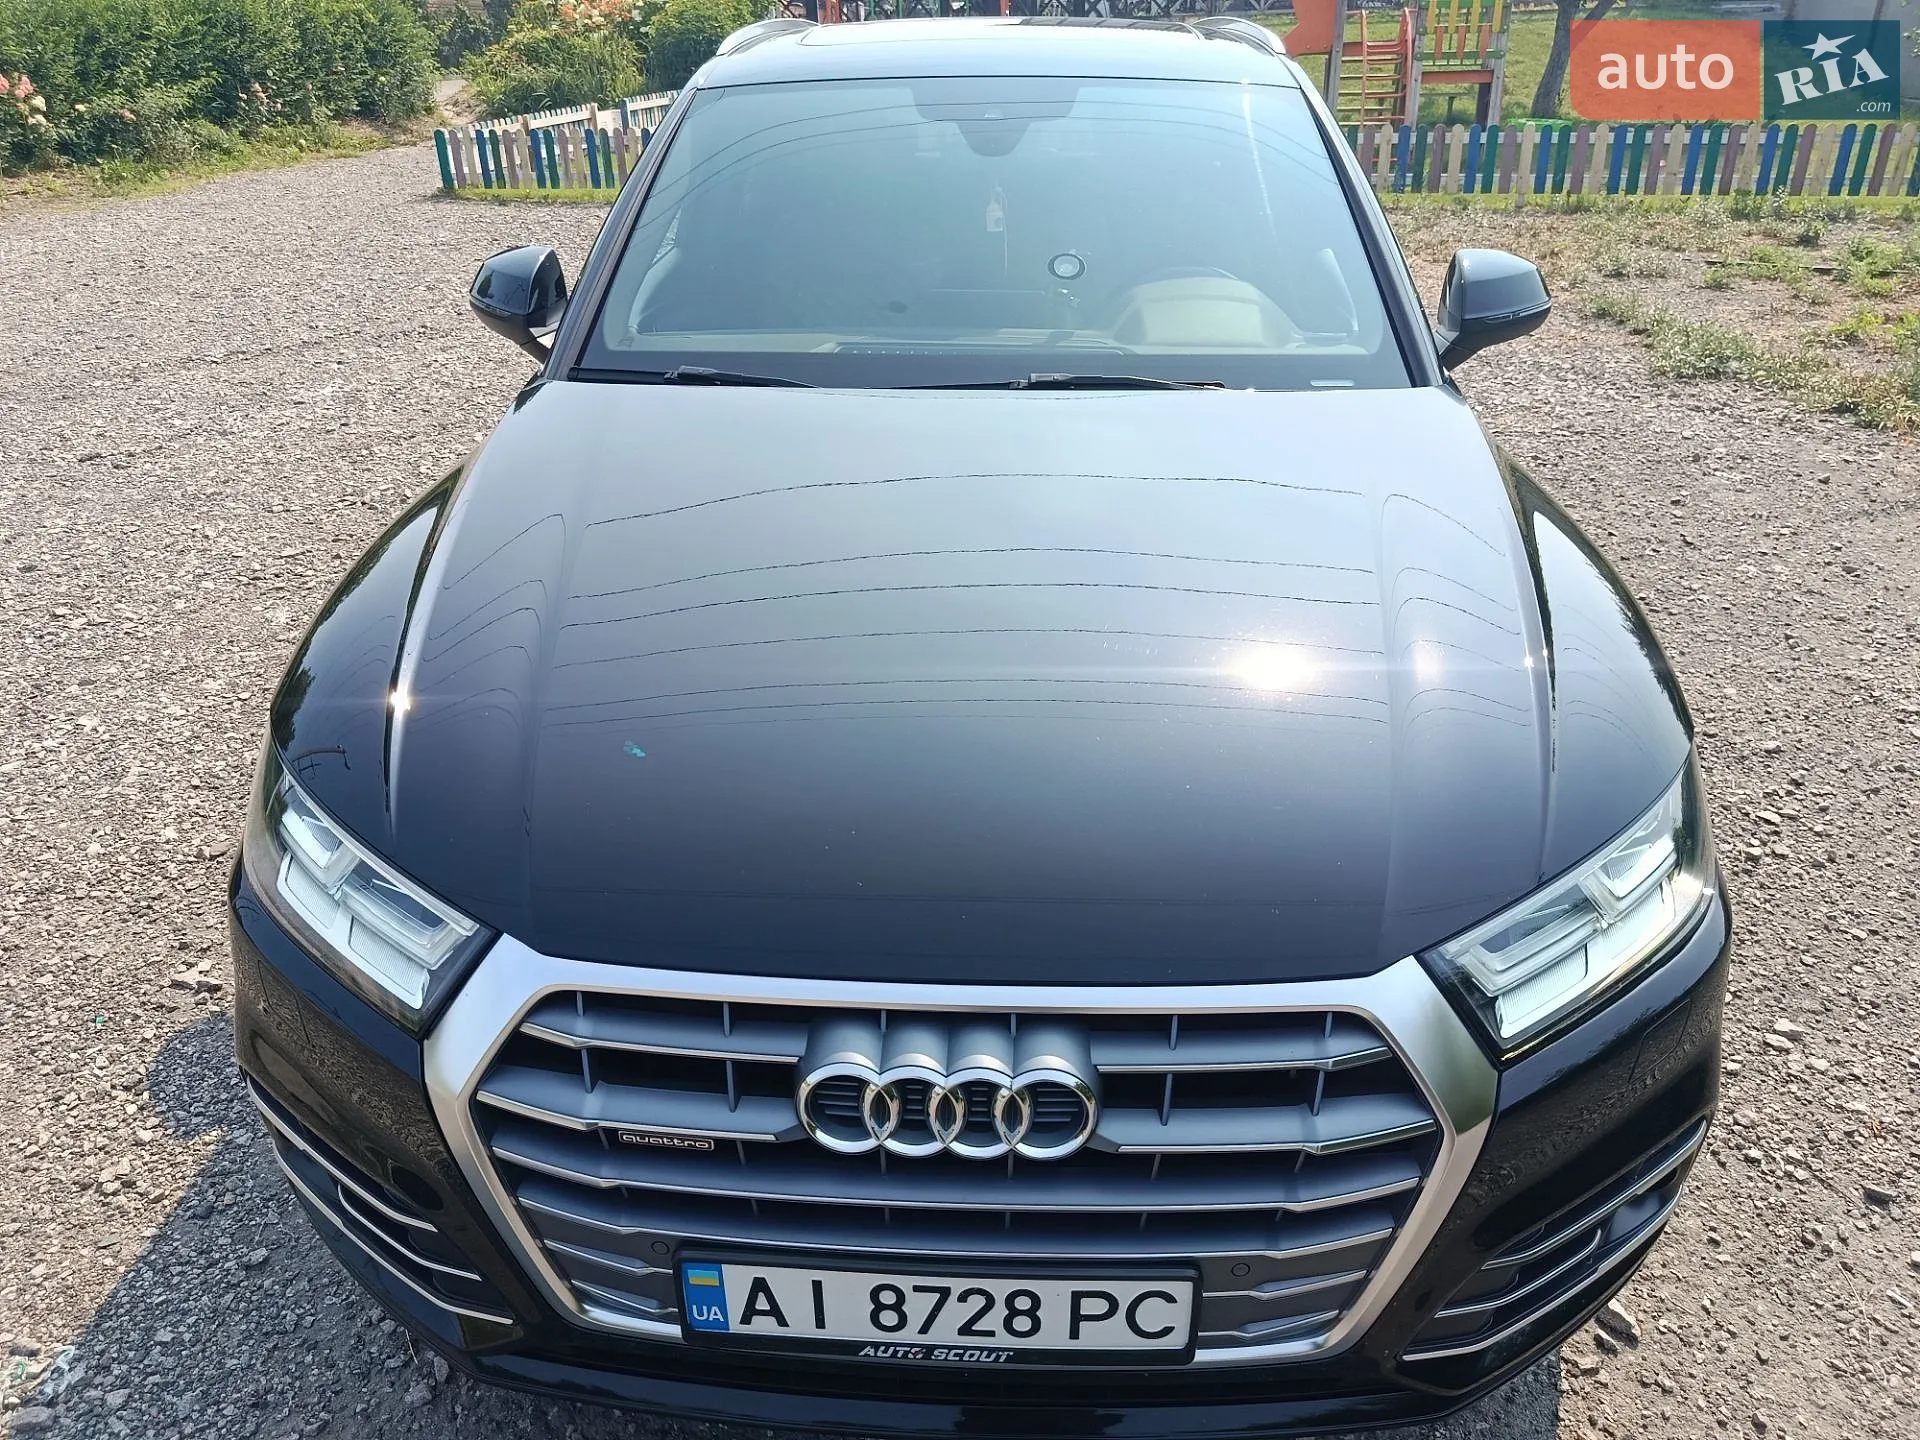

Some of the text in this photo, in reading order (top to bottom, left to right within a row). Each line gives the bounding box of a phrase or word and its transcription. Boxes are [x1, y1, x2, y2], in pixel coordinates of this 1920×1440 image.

[622, 1134, 709, 1148] quattro
[692, 1304, 725, 1322] UA
[869, 1283, 1042, 1339] 8728
[1068, 1290, 1179, 1340] PC
[858, 1345, 1014, 1363] AUTO SCOUT
